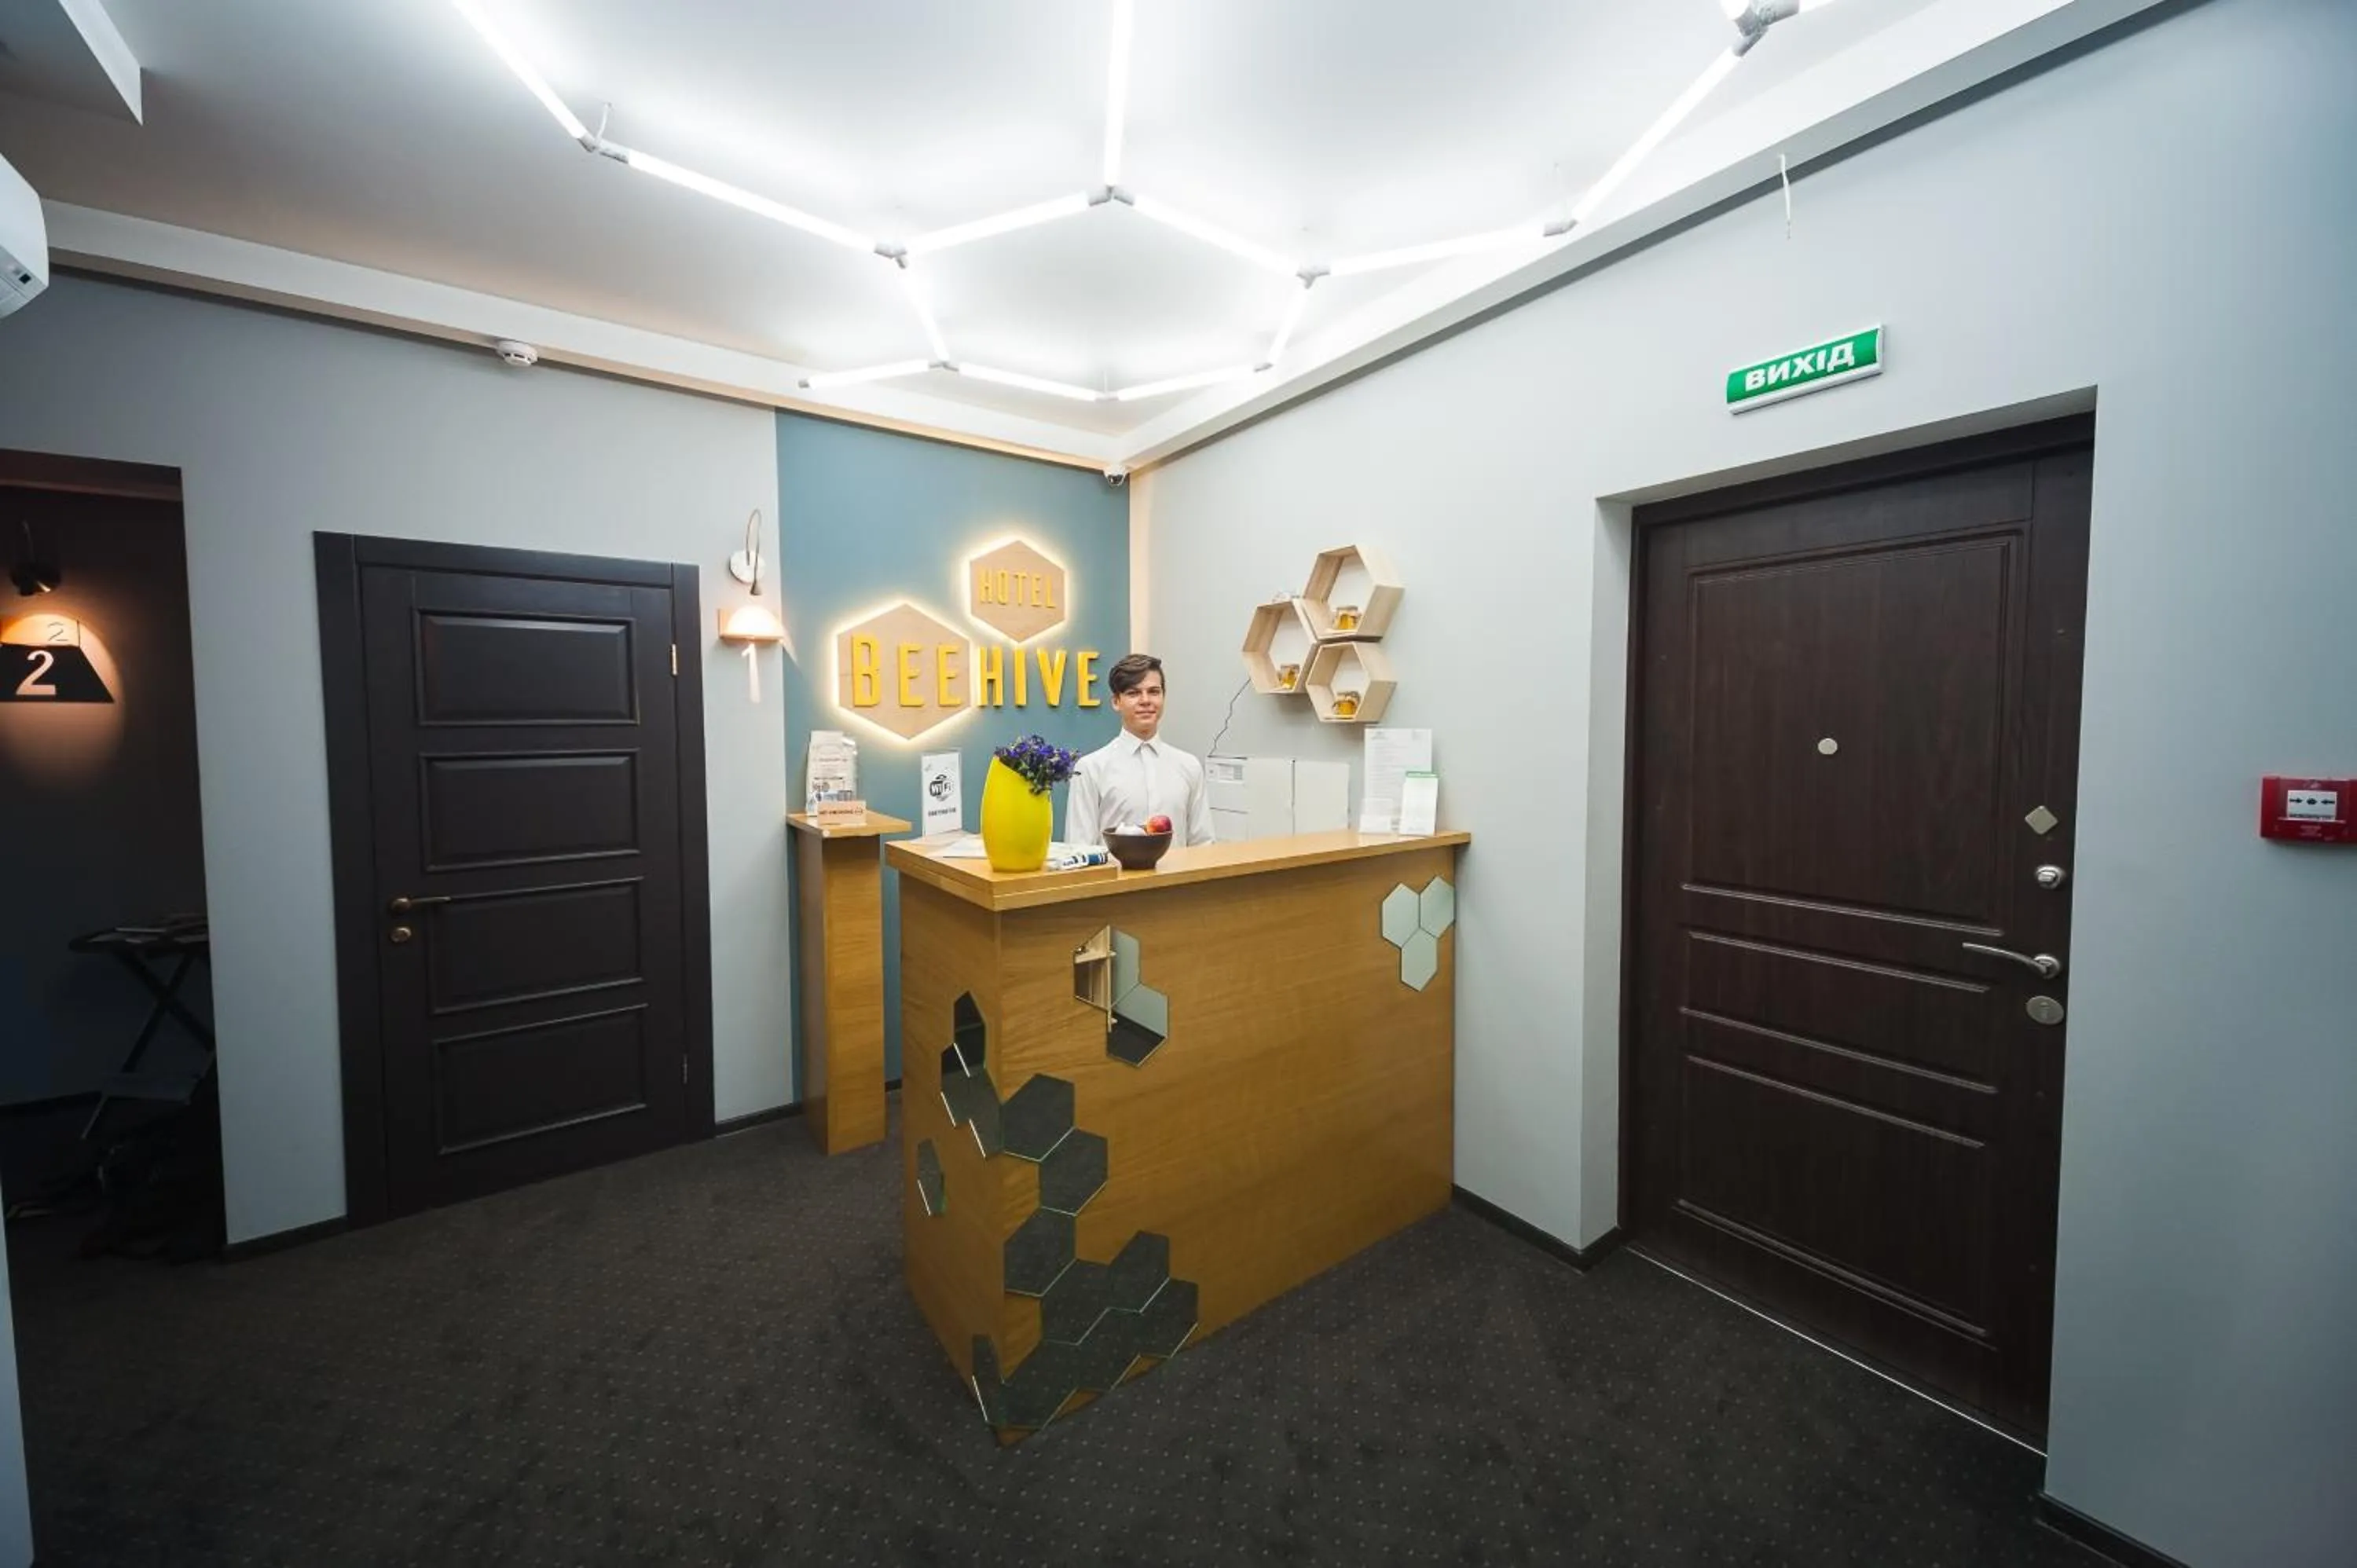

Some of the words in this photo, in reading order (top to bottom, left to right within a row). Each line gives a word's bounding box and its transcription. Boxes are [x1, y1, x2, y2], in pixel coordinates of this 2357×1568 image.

[1745, 342, 1855, 391] ВИХІД
[978, 567, 1057, 609] HOTEL
[16, 650, 56, 695] 2
[741, 643, 761, 704] 1
[851, 633, 1102, 708] BEEHIVE
